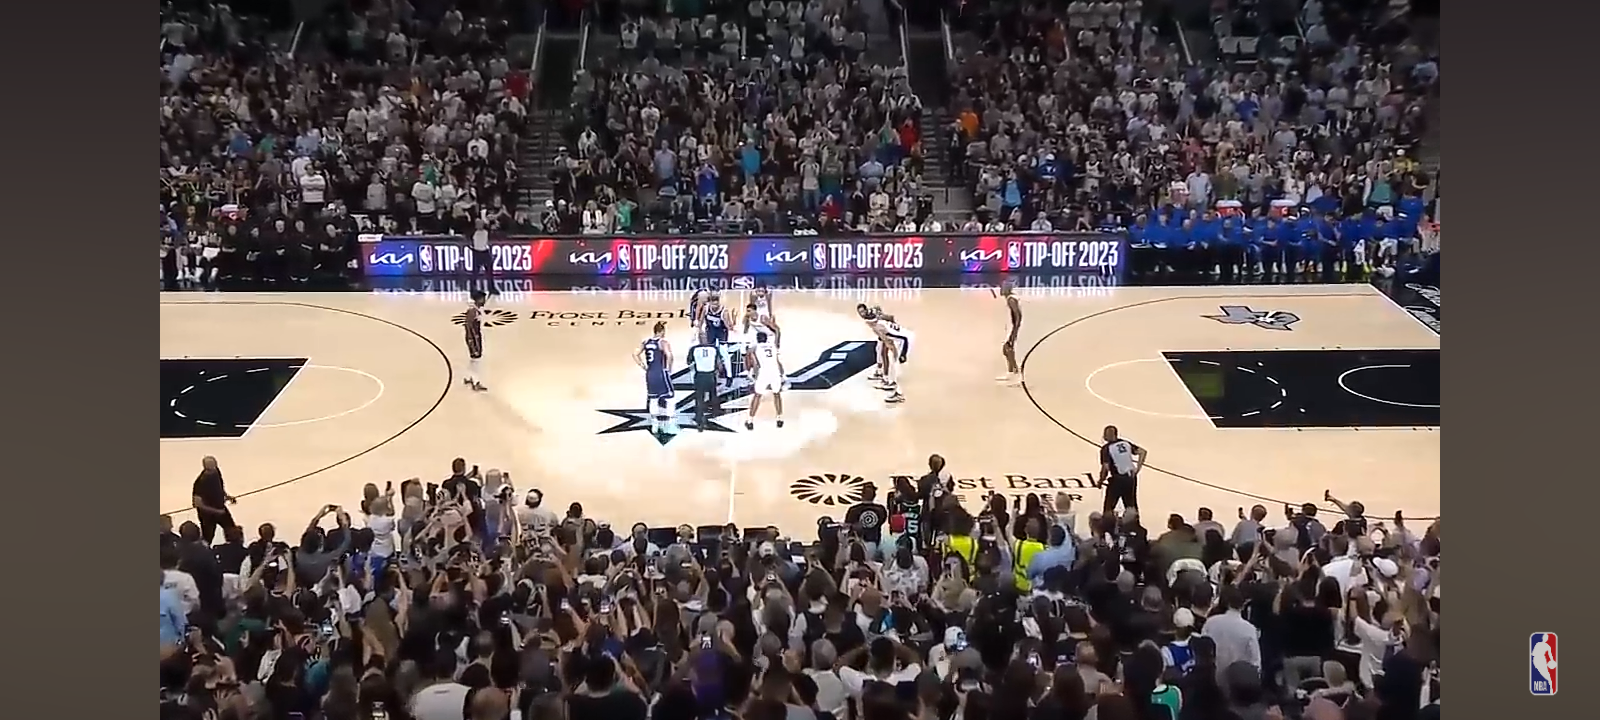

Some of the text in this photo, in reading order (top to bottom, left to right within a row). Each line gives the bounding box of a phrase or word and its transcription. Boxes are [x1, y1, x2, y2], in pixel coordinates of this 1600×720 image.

[434, 245, 474, 271] TIP-O
[491, 245, 532, 271] 2023
[633, 244, 686, 270] TIP-OFF
[688, 244, 729, 270] 2023
[828, 243, 881, 269] TIP-OFF
[883, 243, 923, 269] 2023
[1023, 241, 1076, 267] TIP-OFF
[1078, 241, 1119, 266] 2023
[529, 308, 691, 319] Frost Bank
[764, 349, 773, 357] 3
